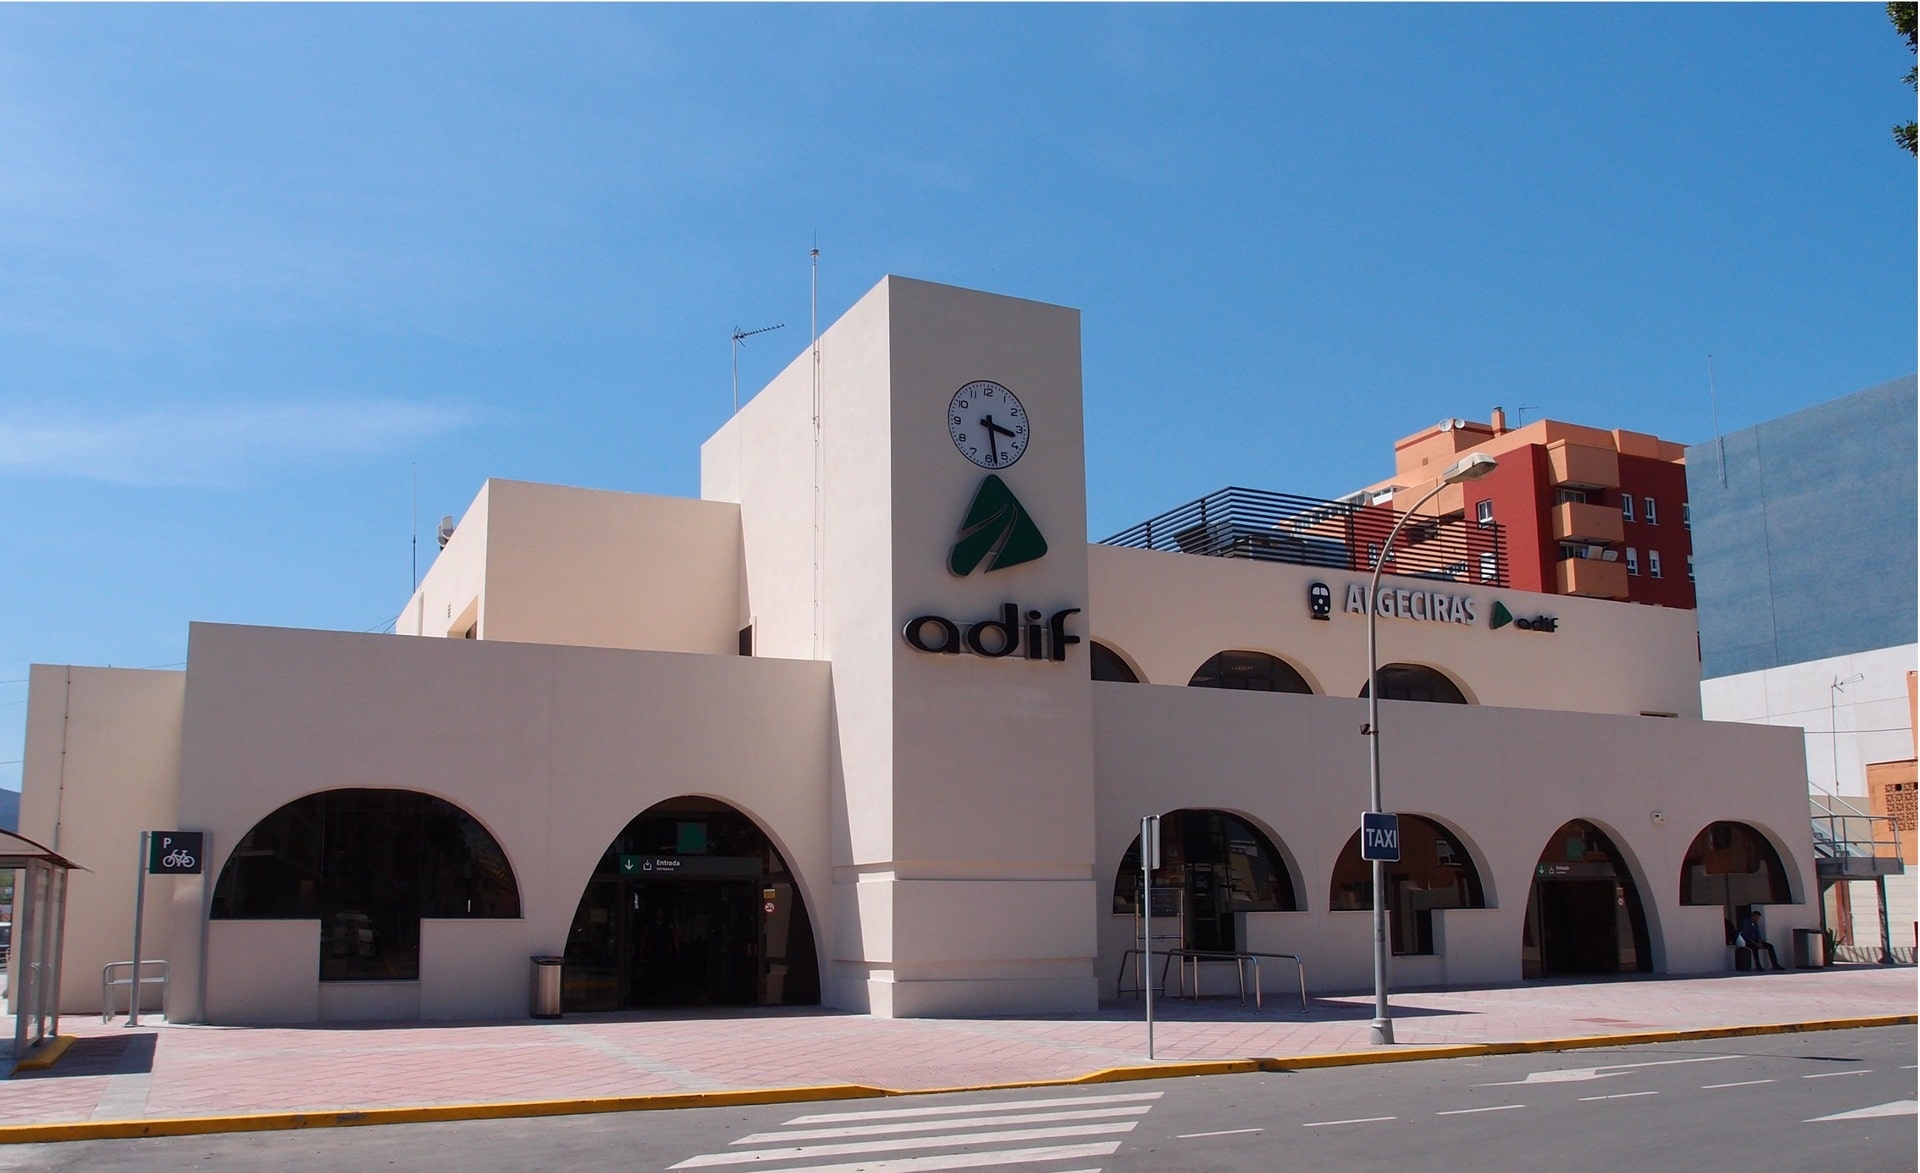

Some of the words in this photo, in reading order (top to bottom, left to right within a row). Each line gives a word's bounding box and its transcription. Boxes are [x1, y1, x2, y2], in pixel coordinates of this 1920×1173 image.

[970, 390, 977, 399] 11
[983, 388, 993, 397] 12
[958, 399, 969, 409] 10
[1010, 408, 1018, 417] 2
[954, 416, 961, 425] 9
[1015, 425, 1023, 434] 3
[958, 433, 966, 442] 8
[1011, 441, 1019, 450] 4
[969, 447, 977, 456] 7
[1000, 452, 1008, 460] 5
[985, 454, 993, 463] 6
[1516, 615, 1559, 632] adif
[903, 602, 1081, 662] adif
[163, 837, 172, 849] P
[1366, 828, 1397, 849] TAXI
[656, 859, 681, 867] Entrada
